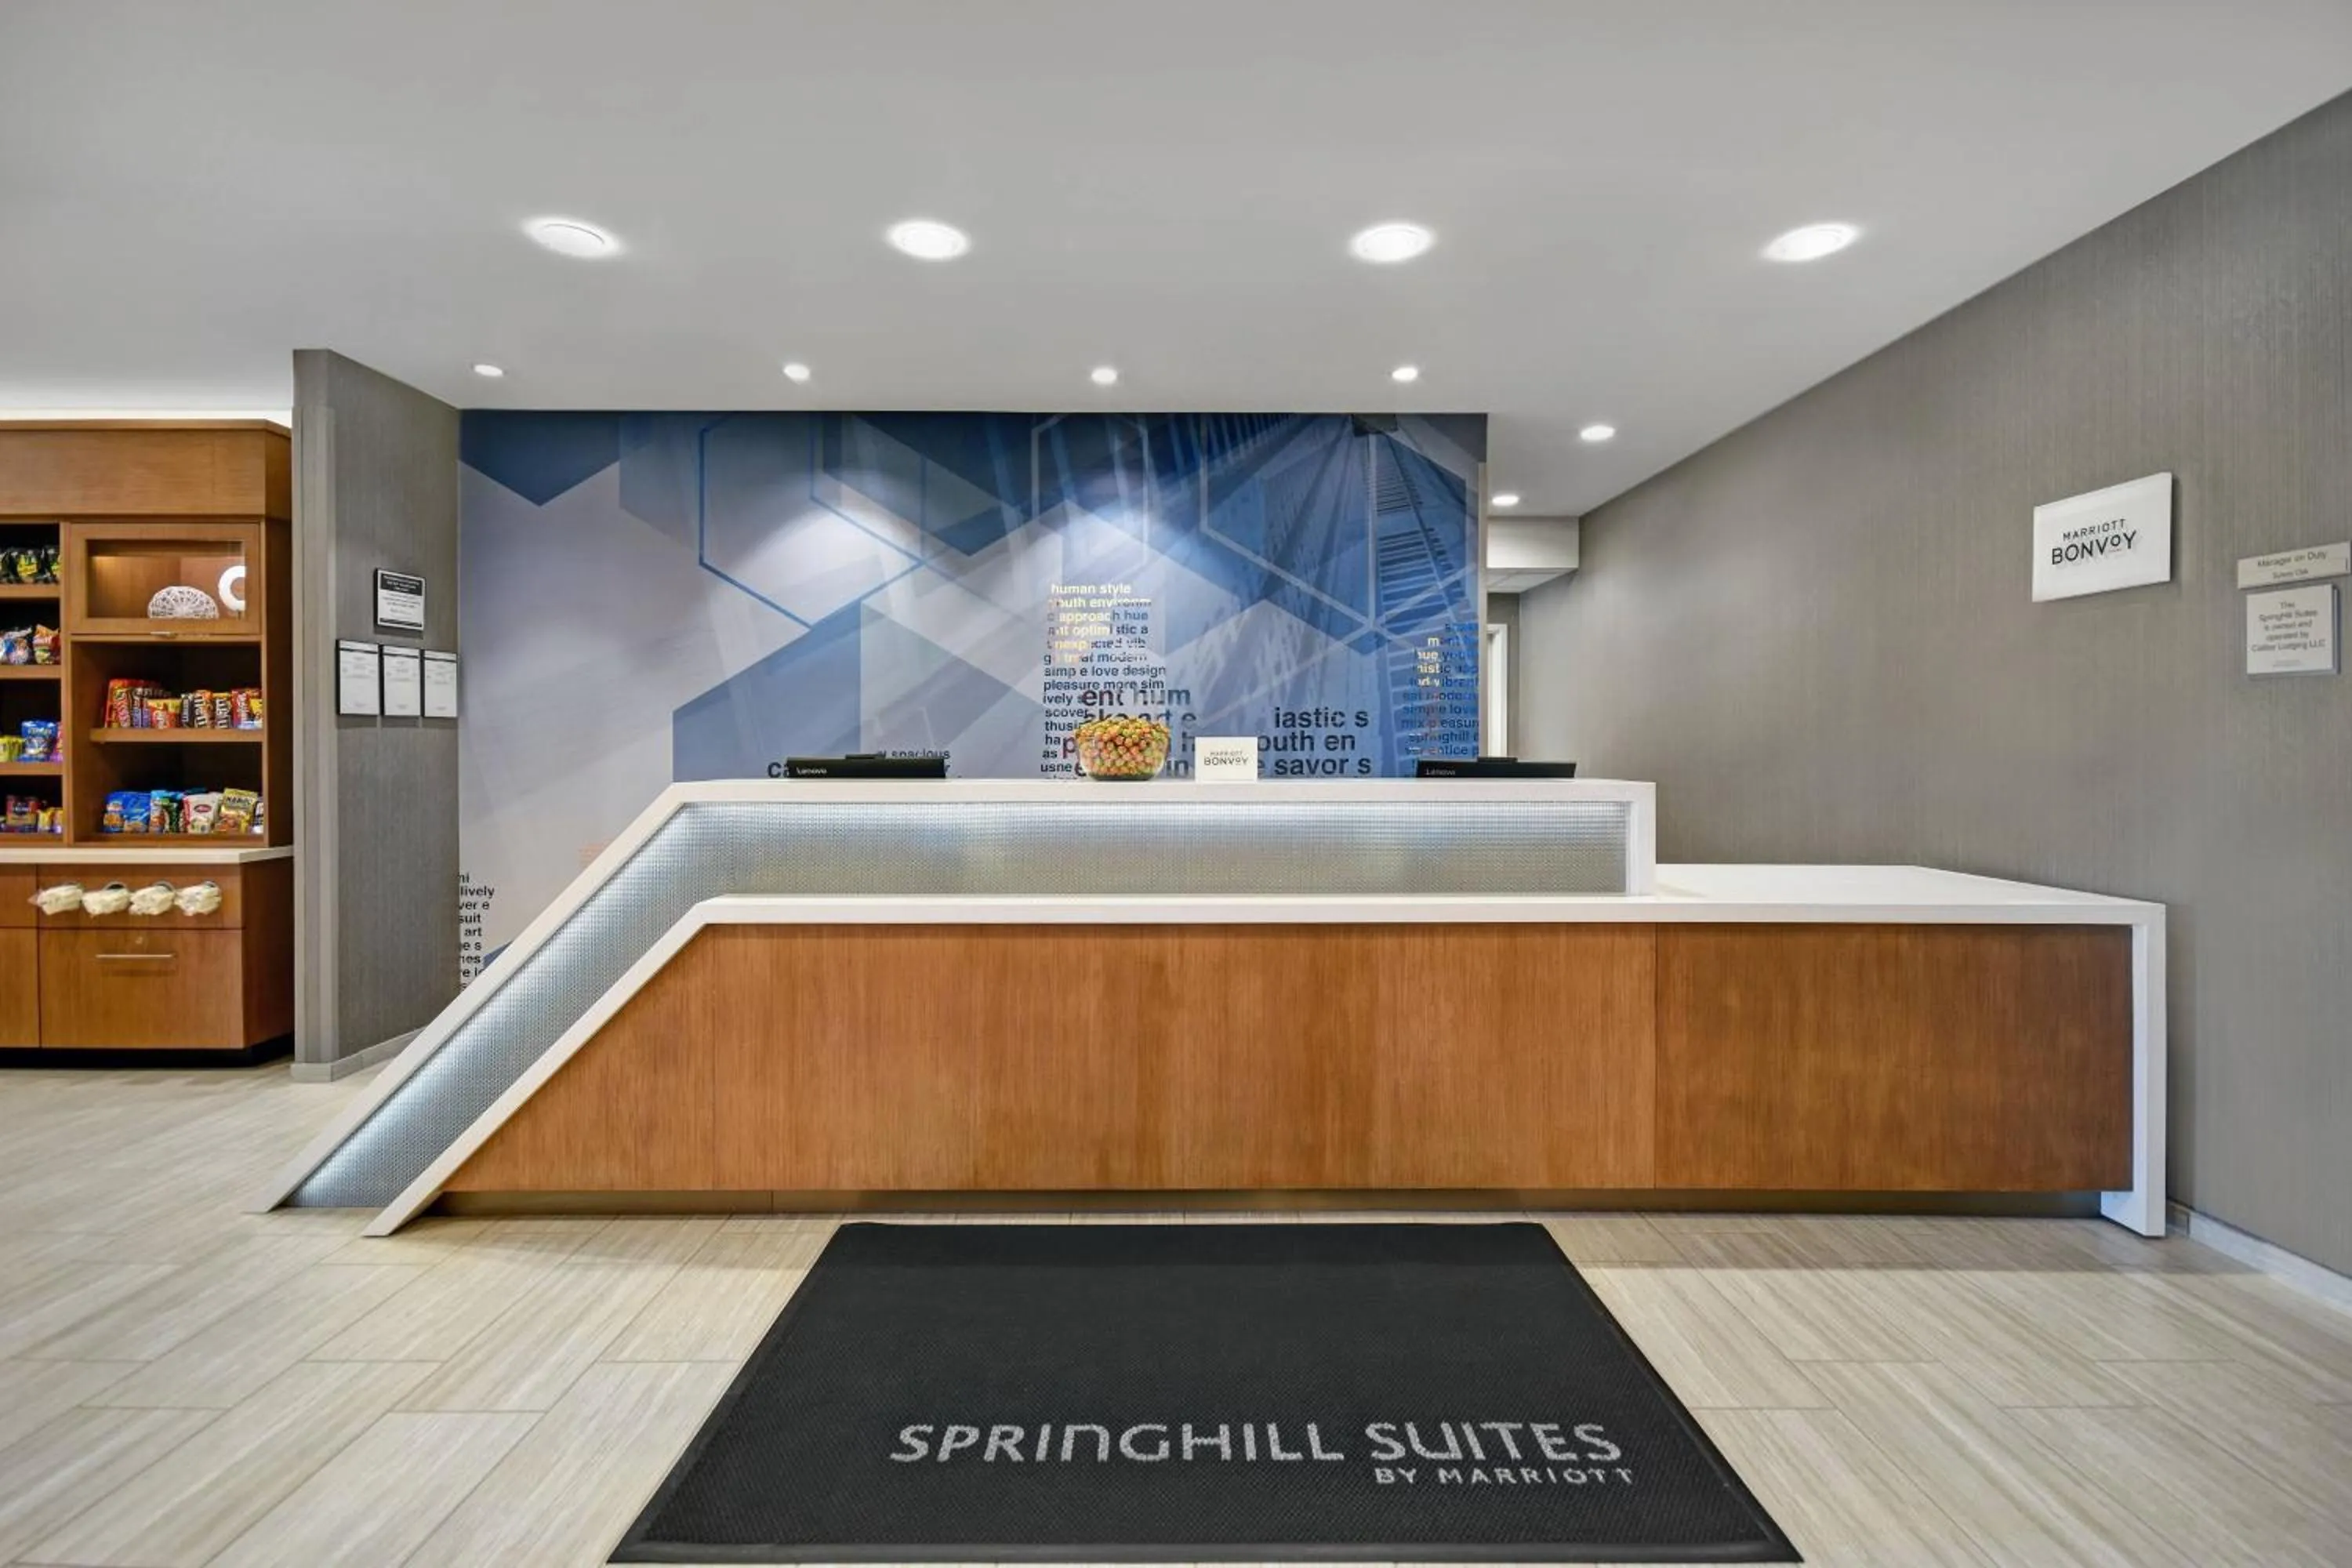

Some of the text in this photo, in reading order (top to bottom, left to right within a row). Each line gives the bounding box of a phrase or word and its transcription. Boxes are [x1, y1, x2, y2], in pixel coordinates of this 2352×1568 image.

[2062, 518, 2126, 541] MARRIOTT
[2052, 530, 2136, 565] BONVOY
[1051, 583, 1132, 597] human style
[1091, 665, 1120, 677] love
[1123, 665, 1167, 679] design
[1044, 680, 1100, 692] pleasure
[1140, 678, 1165, 689] sim
[1275, 707, 1370, 728] iastic s
[1324, 735, 1356, 751] en
[1203, 757, 1249, 766] BONVOY
[1274, 757, 1349, 775] savor
[1357, 757, 1371, 775] s
[464, 927, 482, 937] art
[474, 942, 482, 951] s
[890, 1421, 1621, 1462] SPRINGHILL SUITES
[1374, 1467, 1632, 1485] BY MARRIOTT
